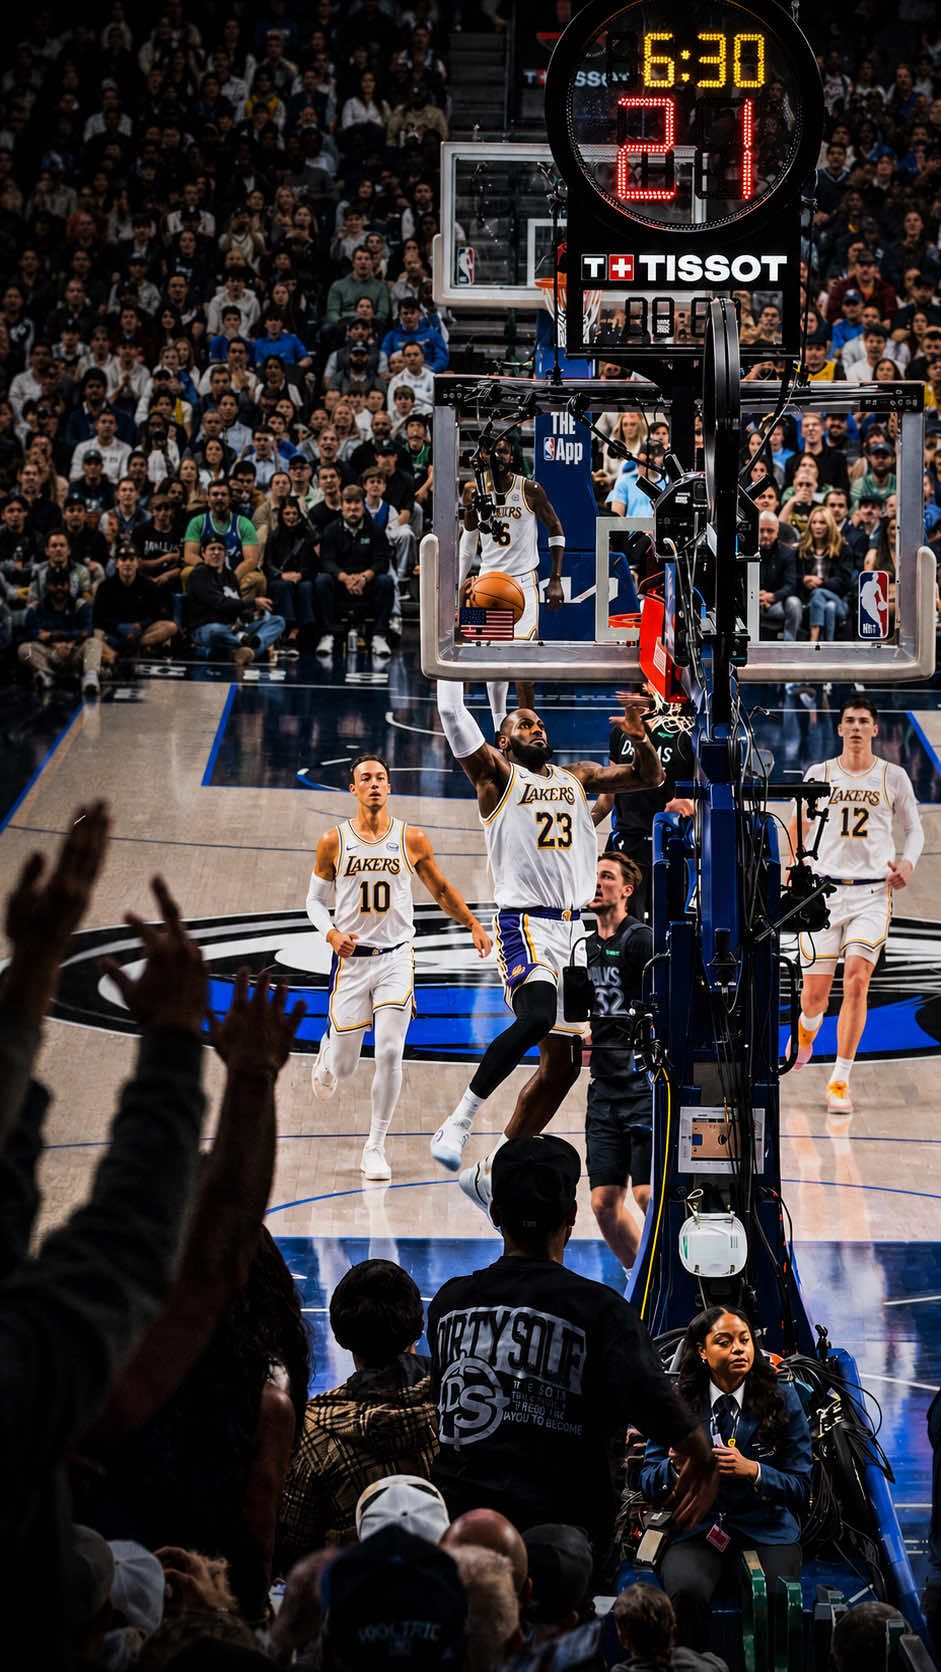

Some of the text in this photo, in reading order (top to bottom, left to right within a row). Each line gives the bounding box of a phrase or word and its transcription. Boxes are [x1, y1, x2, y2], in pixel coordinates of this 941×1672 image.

[643, 32, 766, 88] 6:30
[617, 98, 753, 200] 21
[639, 254, 788, 282] TISSOT
[550, 411, 576, 435] THE
[555, 439, 583, 464] App
[621, 739, 673, 763] DAS
[517, 783, 576, 806] LAKERS
[828, 786, 881, 806] LAKERS
[536, 811, 574, 851] 23
[840, 807, 870, 839] 12
[343, 855, 401, 877] LAKERS
[359, 880, 391, 914] 10
[587, 966, 623, 986] AVS
